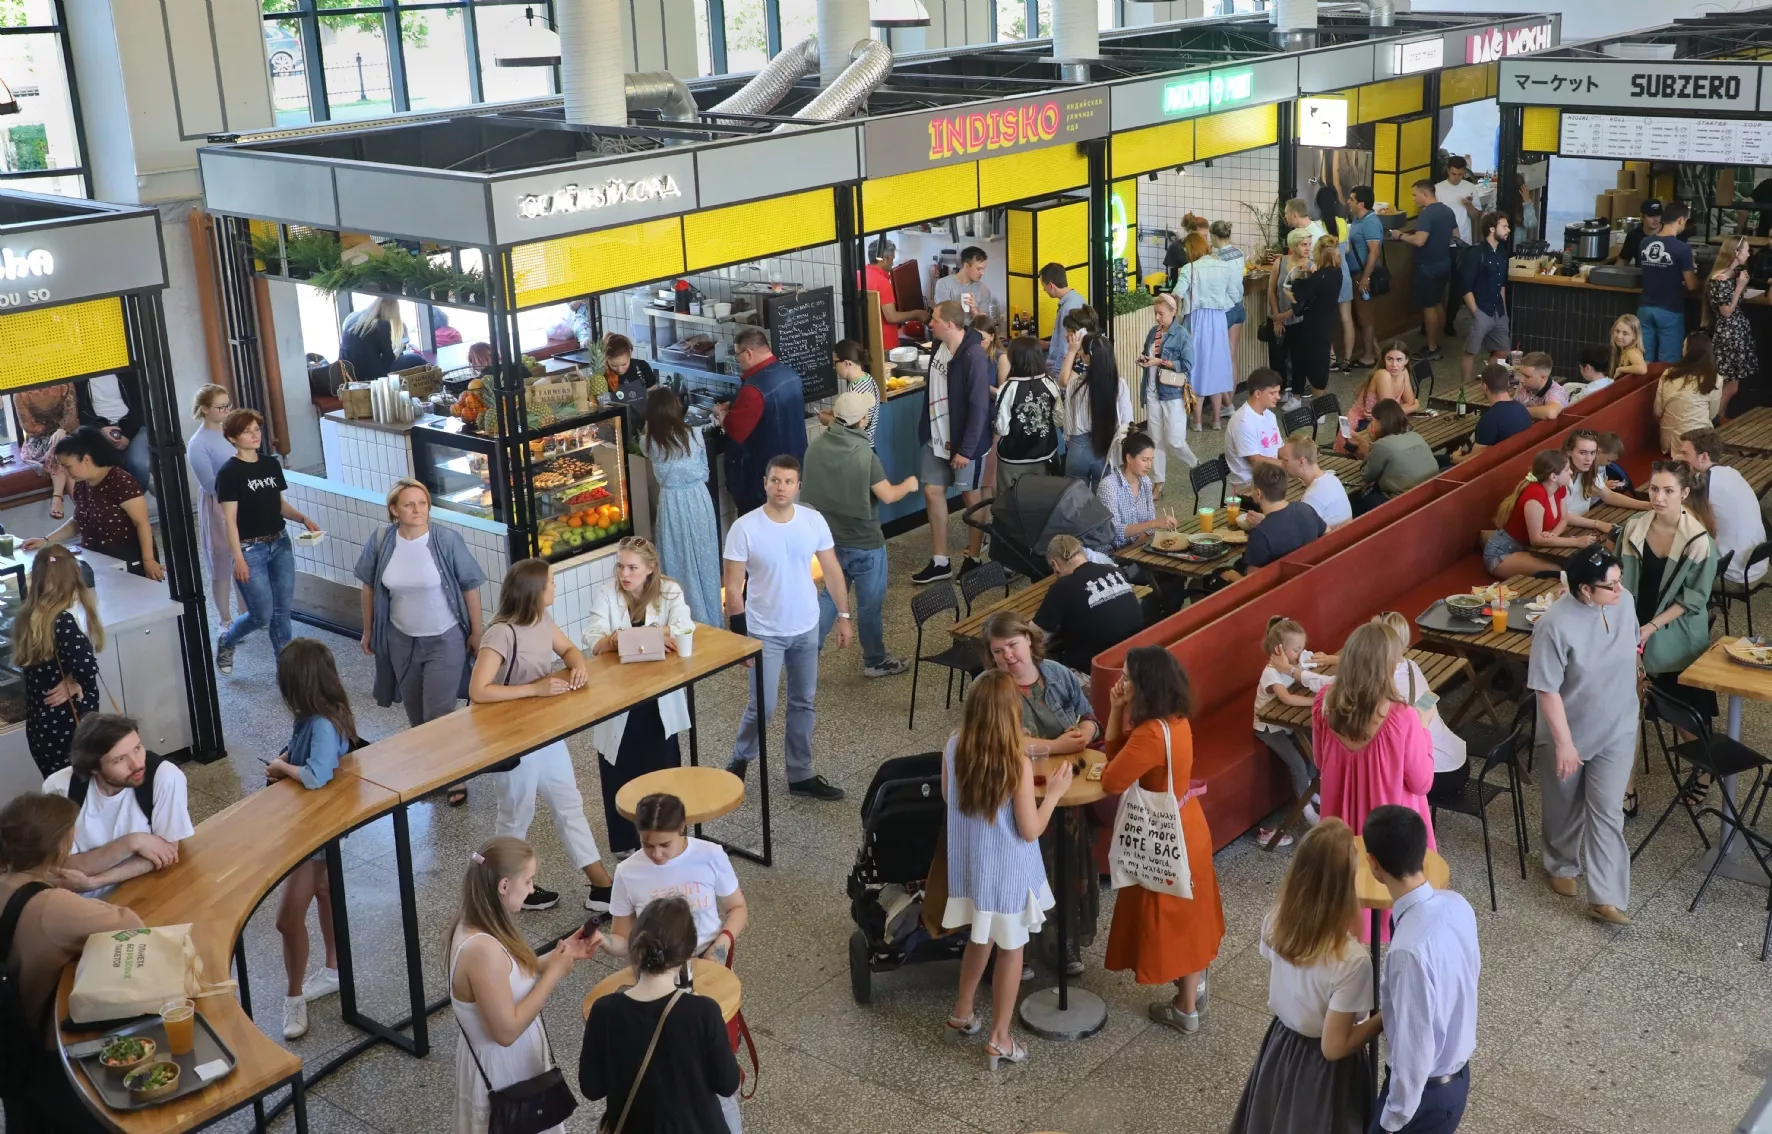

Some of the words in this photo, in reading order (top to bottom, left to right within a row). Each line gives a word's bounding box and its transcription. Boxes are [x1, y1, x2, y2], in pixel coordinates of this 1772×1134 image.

[1506, 24, 1552, 55] MOCHI
[1514, 73, 1599, 93] マーケット
[1630, 73, 1741, 100] SUBZERO
[928, 101, 1061, 160] INDISKO
[1066, 123, 1079, 132] еда
[28, 288, 50, 303] SO
[538, 388, 571, 396] FARMERS
[1127, 812, 1144, 822] room
[1148, 818, 1157, 826] for
[1160, 822, 1174, 830] just
[1124, 822, 1143, 835] one
[1148, 829, 1176, 843] more
[1119, 834, 1146, 852] TOTE
[1154, 842, 1181, 860] BAG
[1123, 848, 1131, 857] in
[1134, 851, 1146, 860] the
[1117, 857, 1124, 866] in
[1128, 860, 1139, 869] my
[1124, 868, 1138, 877] and
[1141, 871, 1150, 880] in
[1153, 875, 1164, 884] my
